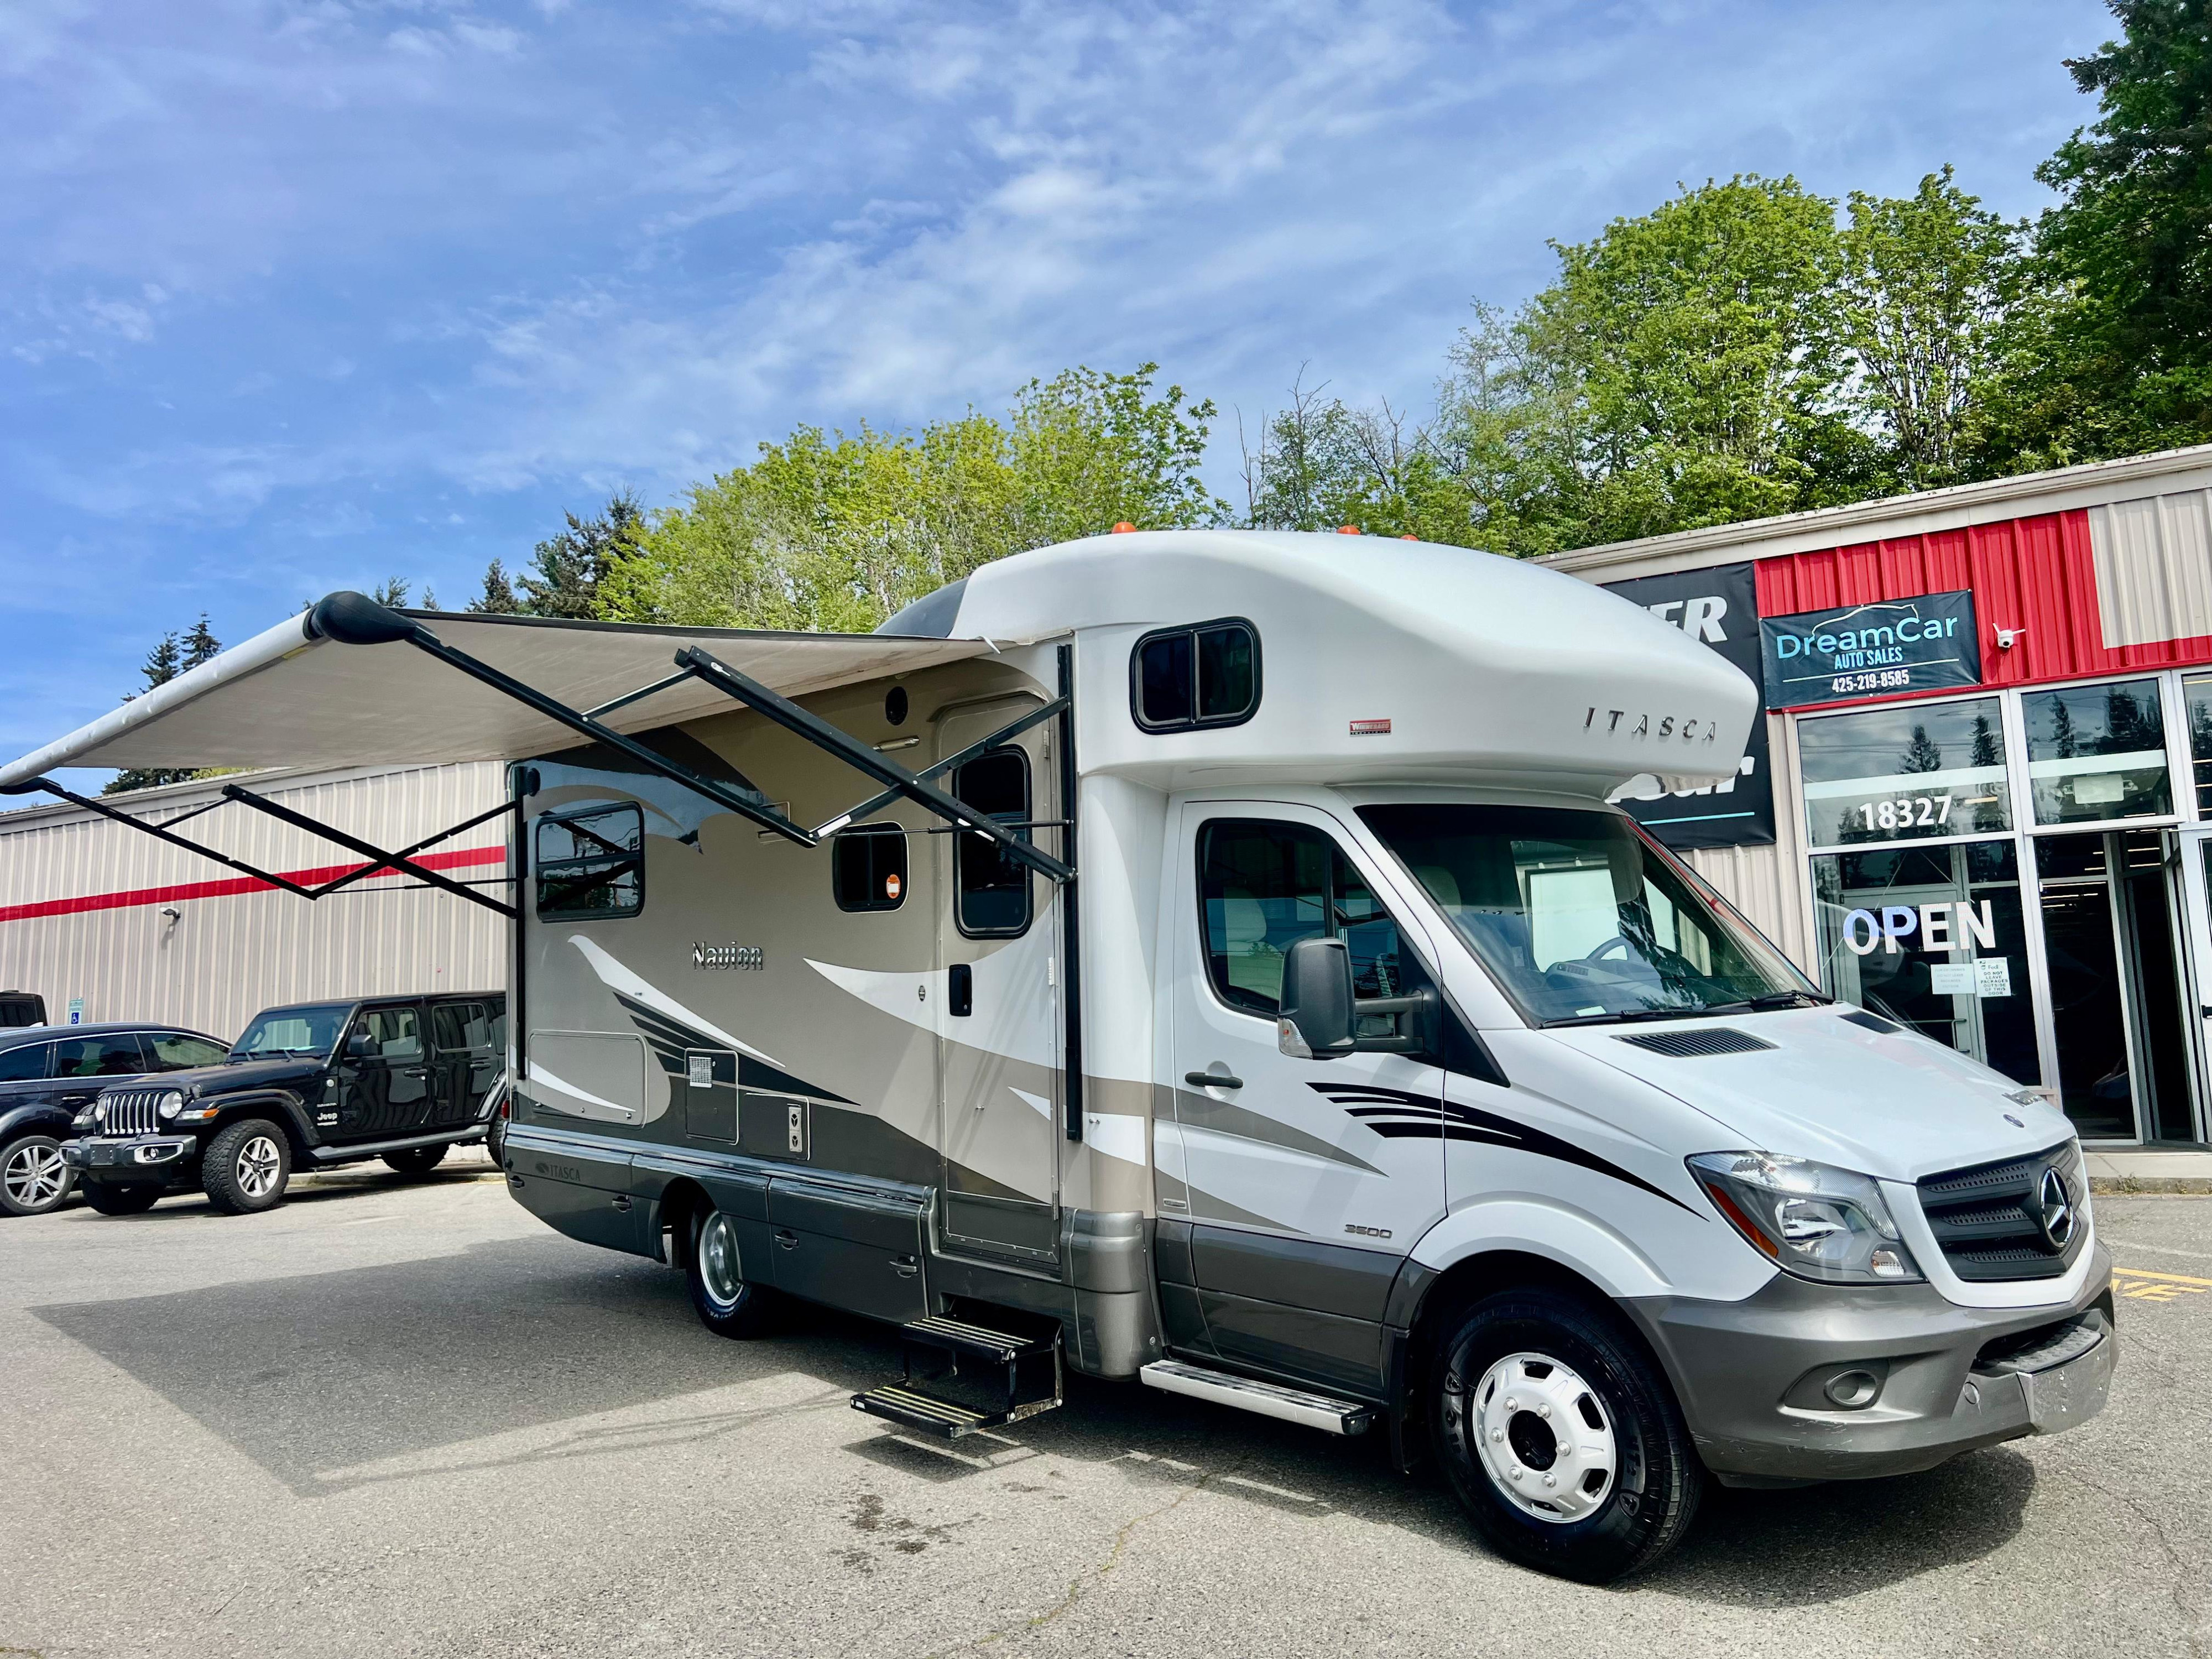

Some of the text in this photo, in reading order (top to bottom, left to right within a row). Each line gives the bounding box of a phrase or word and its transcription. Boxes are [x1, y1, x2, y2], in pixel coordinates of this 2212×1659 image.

[1776, 616, 1958, 659] DreamCar
[1834, 646, 1903, 670] AUTO SALES
[1832, 669, 1910, 693] 425-219-8585
[1583, 707, 1716, 742] ITASCA
[1859, 795, 1952, 831] 18327
[1843, 899, 1996, 956] OPEN
[317, 1112, 338, 1121] Jeep
[550, 1164, 581, 1182] ITASCA
[1344, 1224, 1393, 1239] 3500
